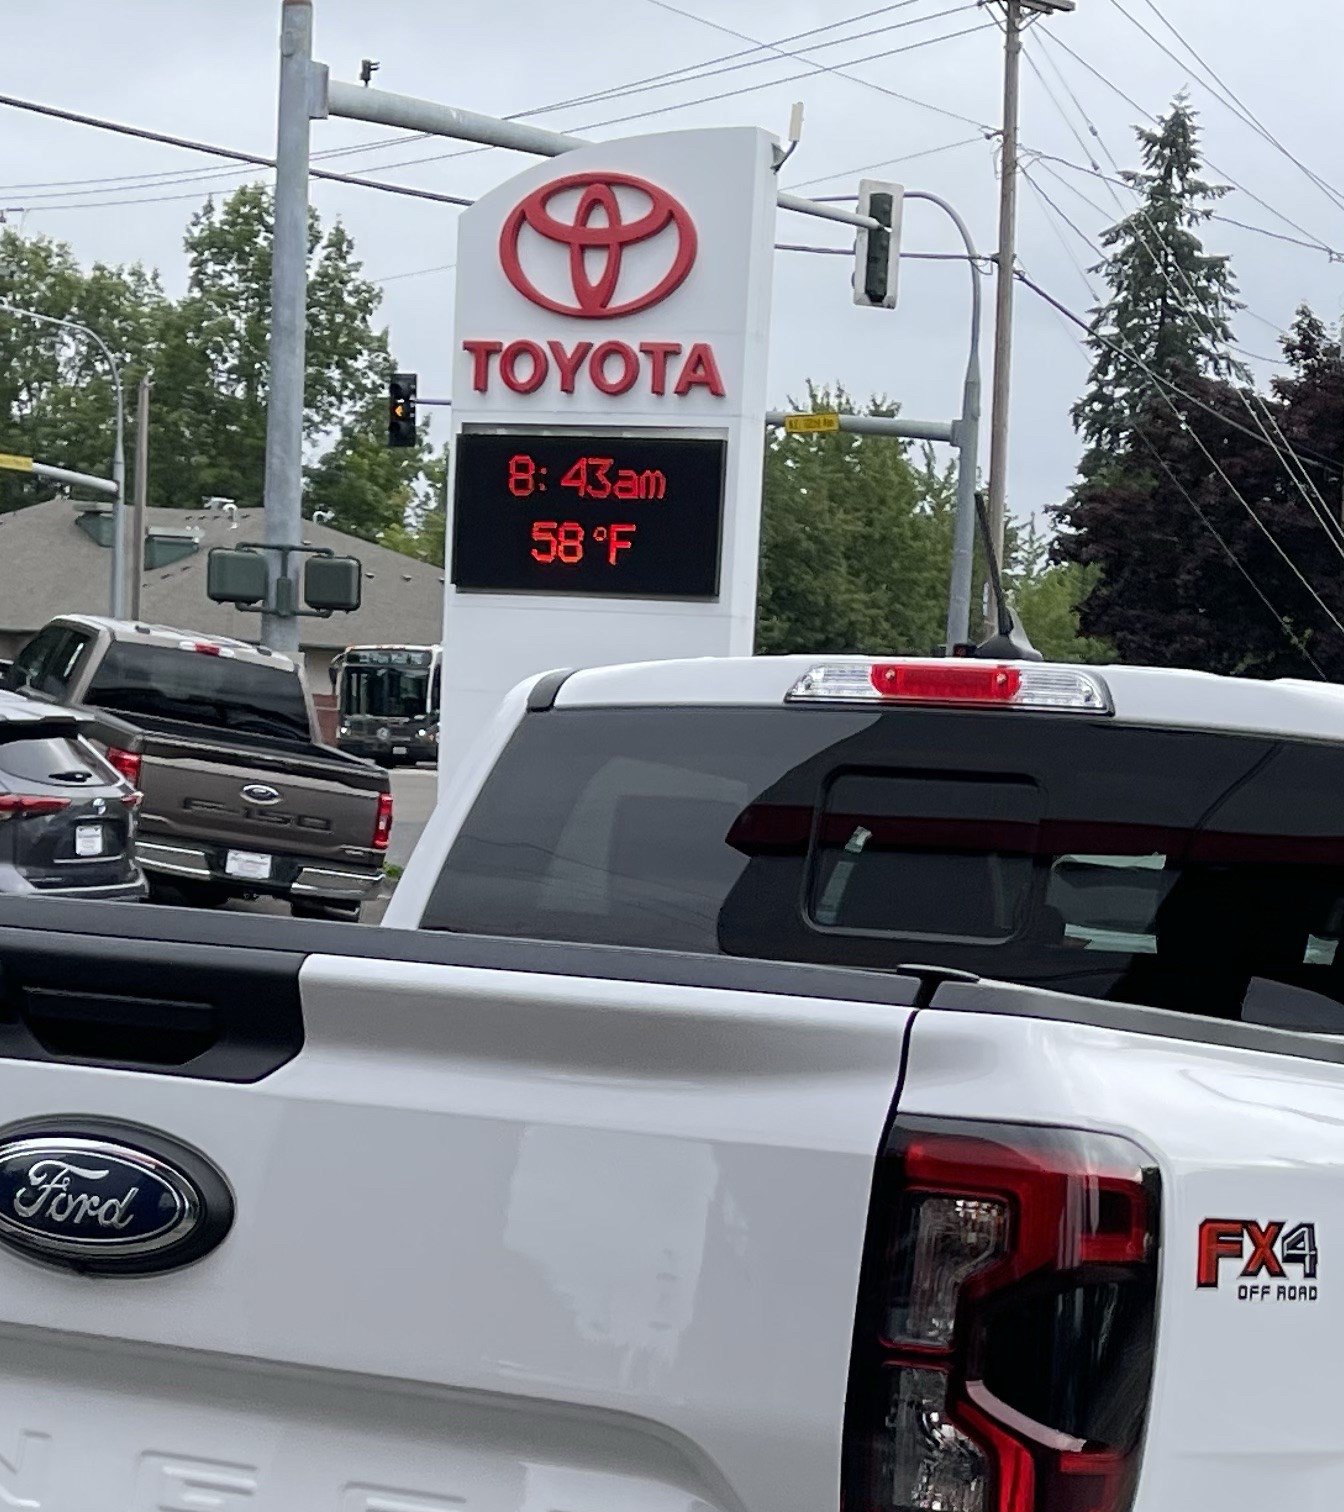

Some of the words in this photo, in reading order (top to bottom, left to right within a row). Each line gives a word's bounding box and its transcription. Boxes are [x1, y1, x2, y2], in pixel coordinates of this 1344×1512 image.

[462, 339, 726, 398] TOYOTA
[13, 1159, 140, 1230] Ford
[1196, 1218, 1318, 1288] FX4
[1237, 1285, 1271, 1301] OFF
[1276, 1285, 1318, 1301] ROAD
